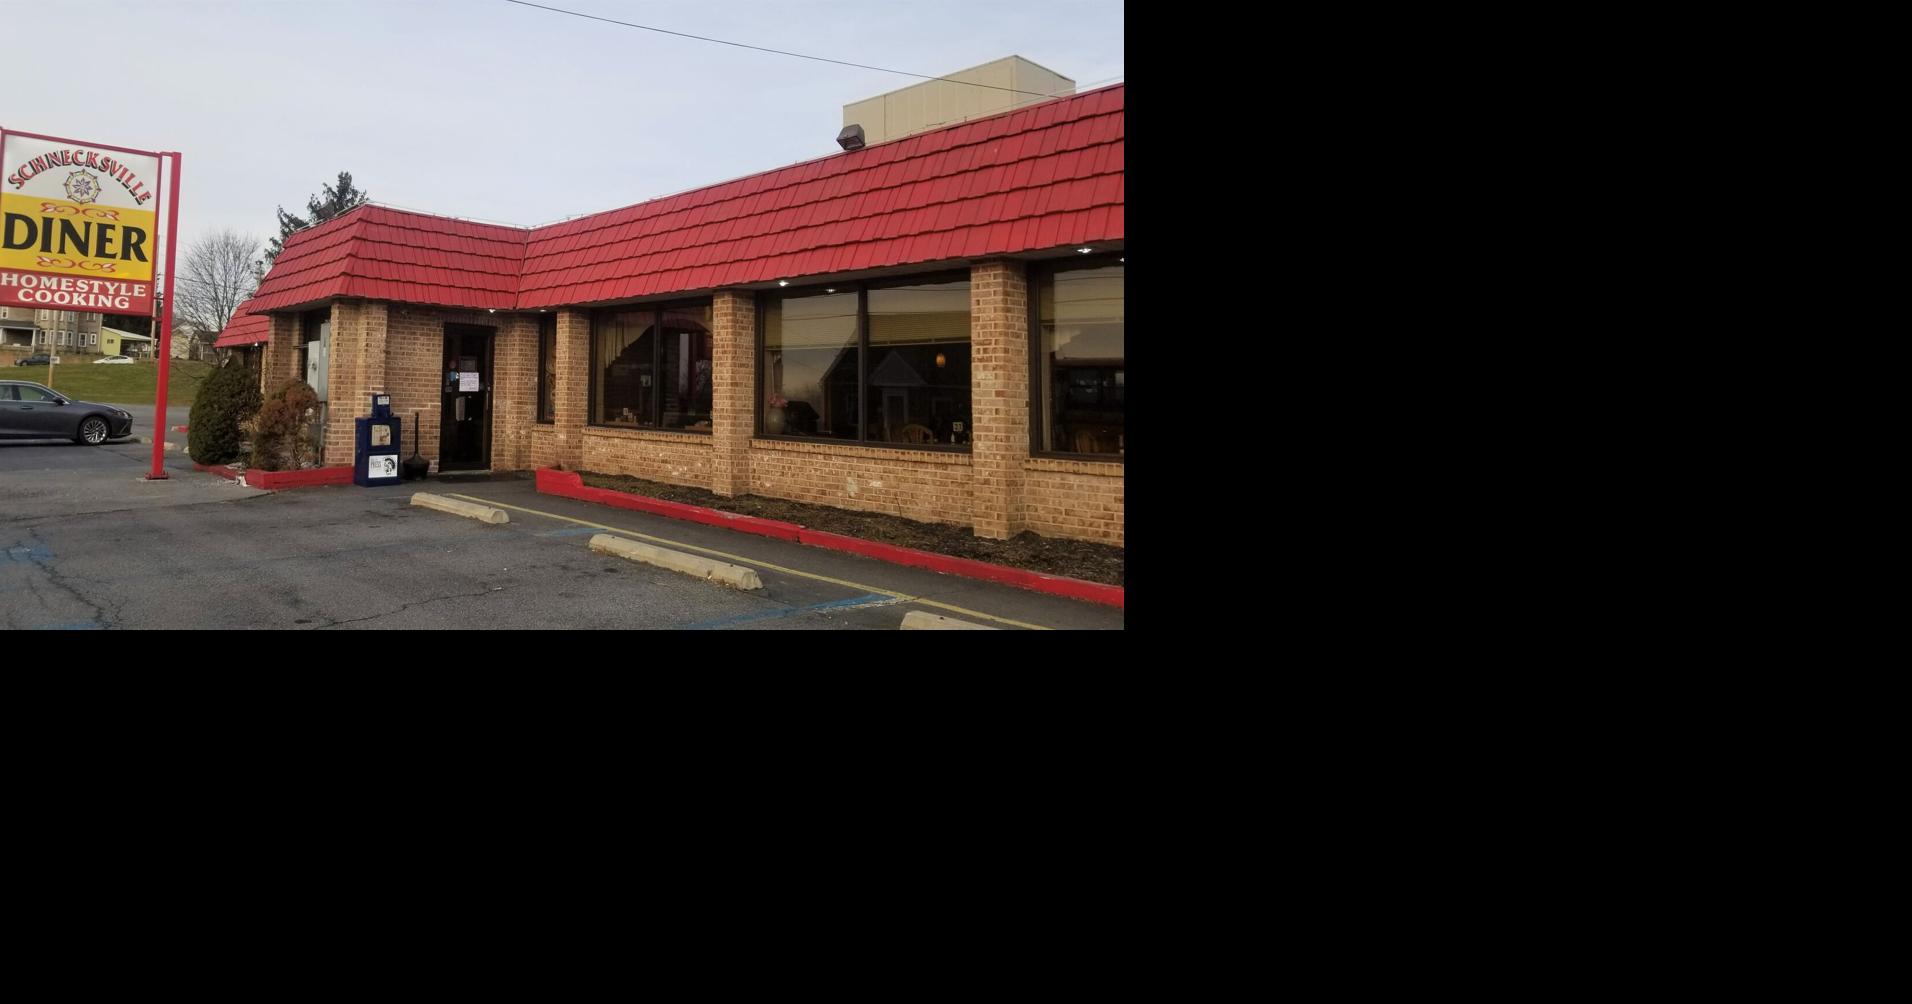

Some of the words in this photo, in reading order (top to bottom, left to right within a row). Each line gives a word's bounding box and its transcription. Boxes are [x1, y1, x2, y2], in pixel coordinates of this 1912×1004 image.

[8, 149, 152, 206] SCHNECKSVILLE
[2, 212, 148, 262] DINER
[0, 272, 146, 297] HOMESTYLE
[17, 289, 130, 309] COOKING
